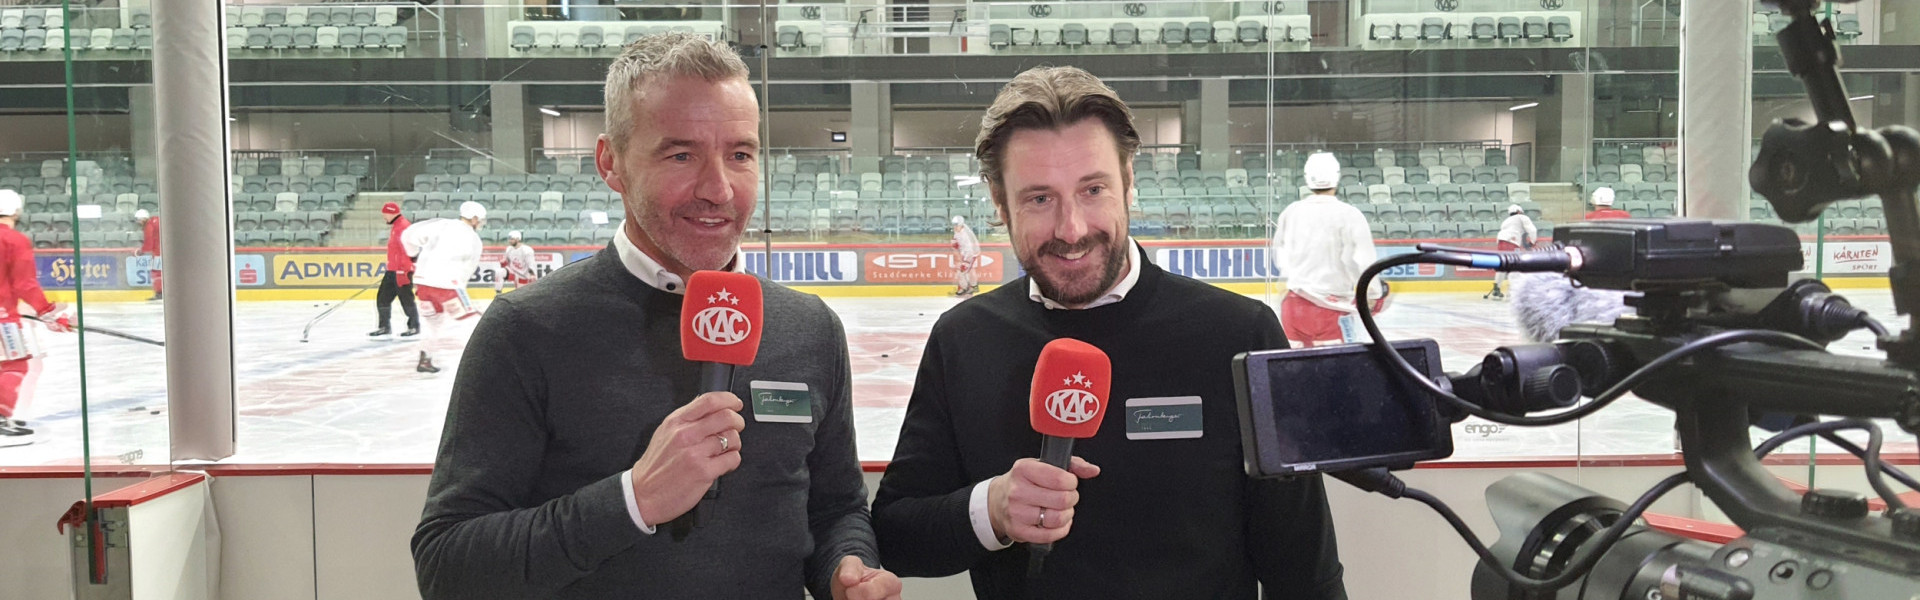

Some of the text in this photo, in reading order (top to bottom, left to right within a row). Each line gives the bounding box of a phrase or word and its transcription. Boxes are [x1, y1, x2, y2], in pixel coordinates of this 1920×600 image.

[1029, 4, 1052, 18] KAC
[1123, 3, 1147, 17] KAC
[51, 258, 110, 282] Hiter
[697, 309, 745, 343] KAC
[1049, 391, 1094, 423] KAC
[1464, 424, 1499, 437] engo
